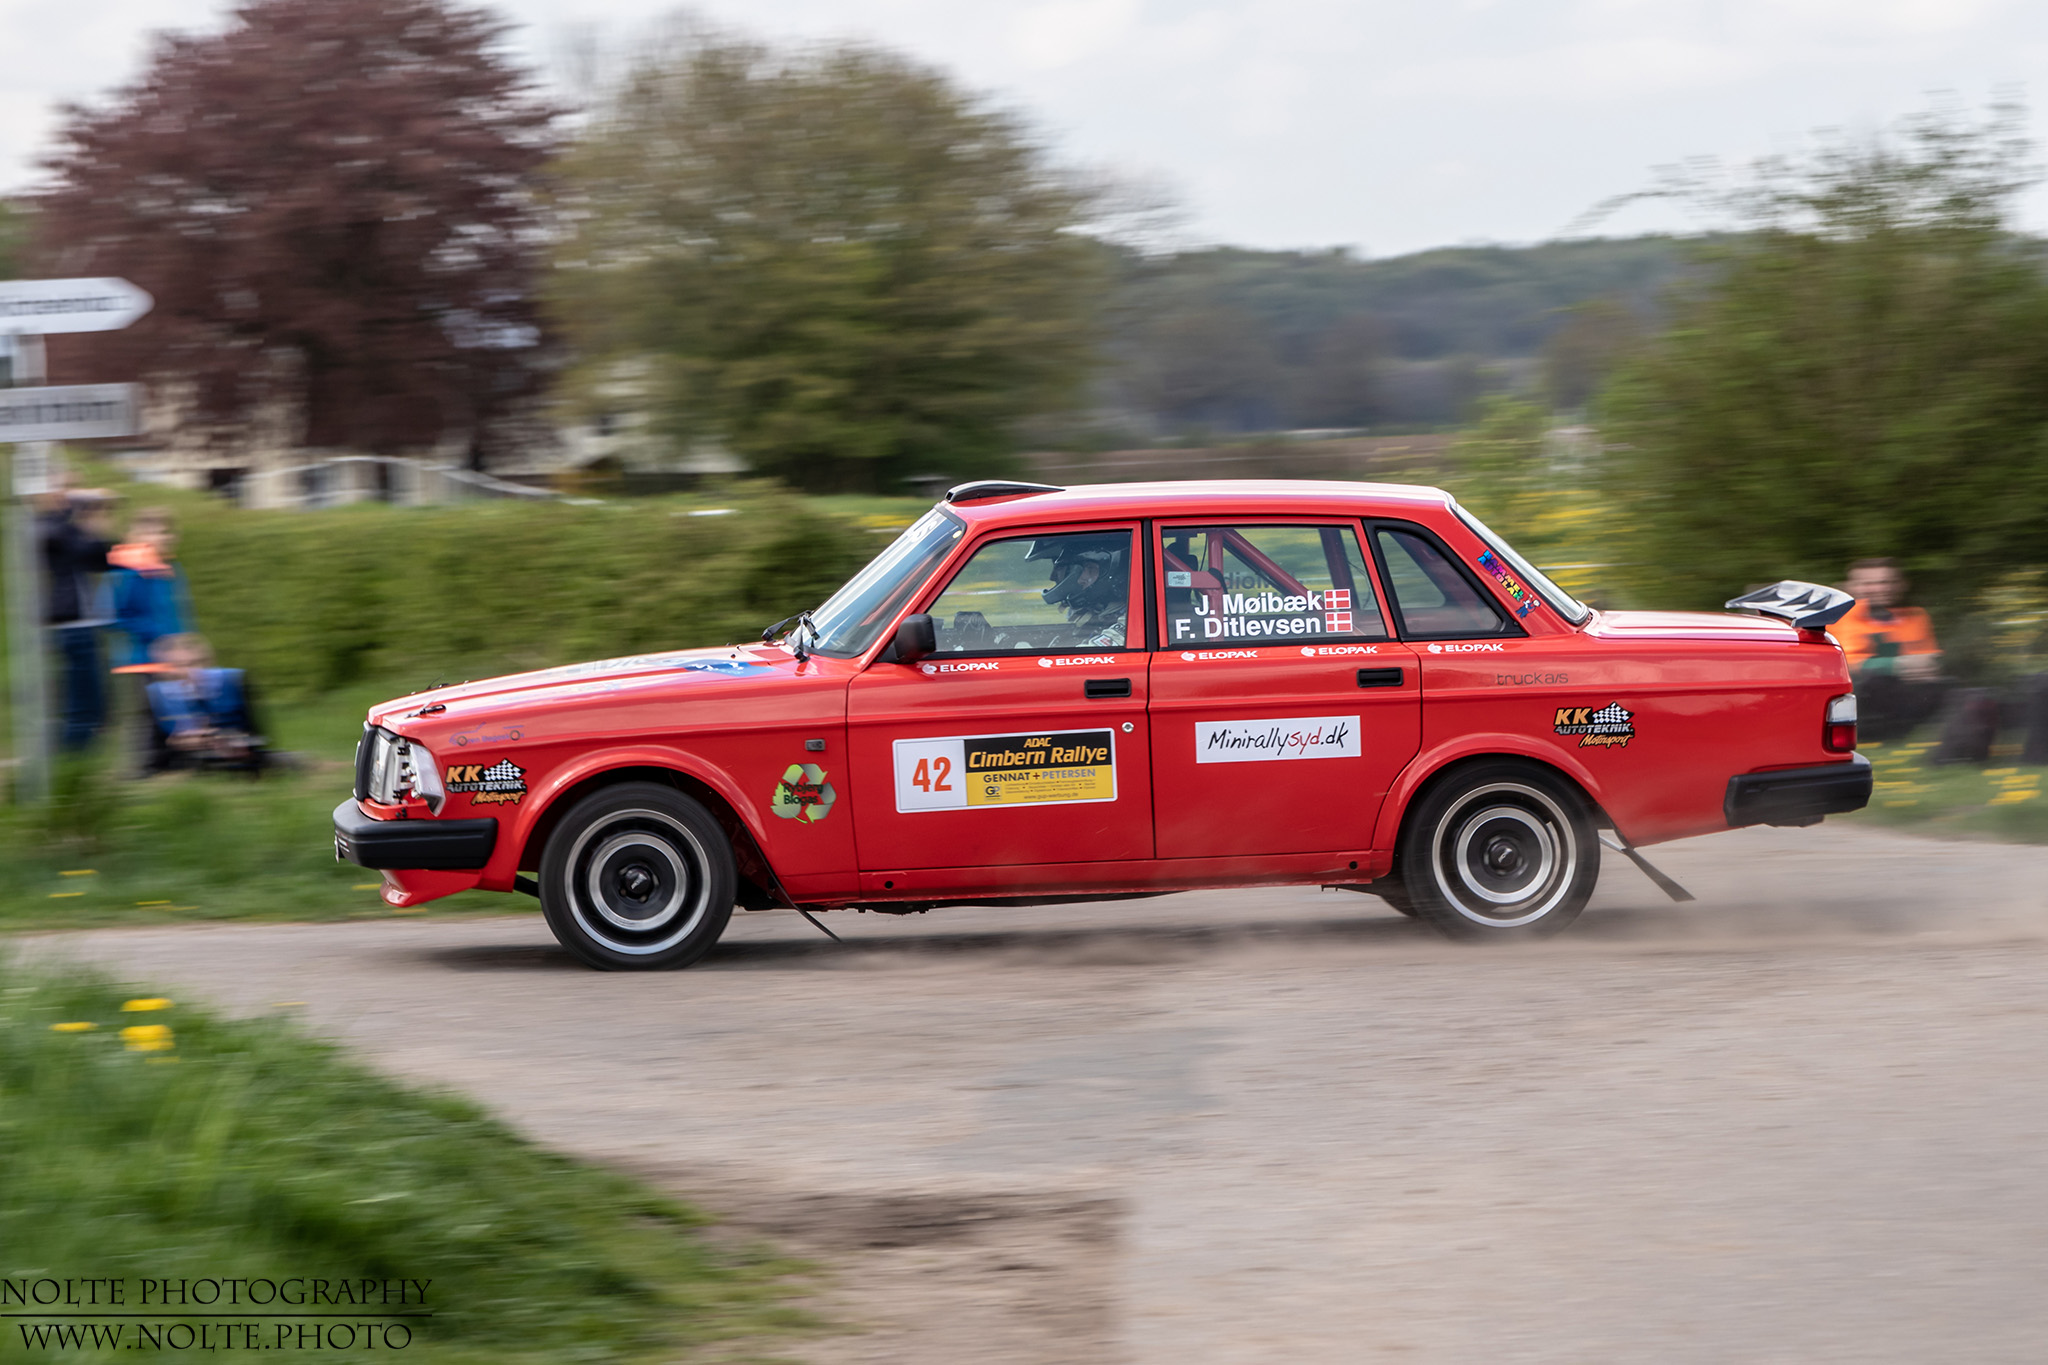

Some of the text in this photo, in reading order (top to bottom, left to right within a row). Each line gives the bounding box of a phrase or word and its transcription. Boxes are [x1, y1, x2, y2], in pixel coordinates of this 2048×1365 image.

[1477, 556, 1523, 602] AUTOLAK
[1194, 590, 1322, 616] J. Møibæk
[1176, 615, 1320, 640] F. Ditlevsen
[1199, 650, 1258, 660] ELOPAK
[1318, 645, 1378, 655] ELOPAK
[1445, 643, 1504, 652] ELOPAK
[940, 662, 999, 672] ELOPAK
[1055, 656, 1115, 666] ELOPAK
[1554, 708, 1592, 725] KK
[1024, 737, 1052, 748] ADAC
[1208, 722, 1349, 756] Minirallysyd.dk
[1579, 734, 1634, 748] Motorsport
[969, 746, 1107, 768] Cimbern Rallye
[446, 765, 482, 783] KK
[912, 757, 952, 793] 42
[983, 772, 1030, 783] GENNAT
[1042, 768, 1096, 779] PETERSEN
[783, 794, 818, 806] Biogas
